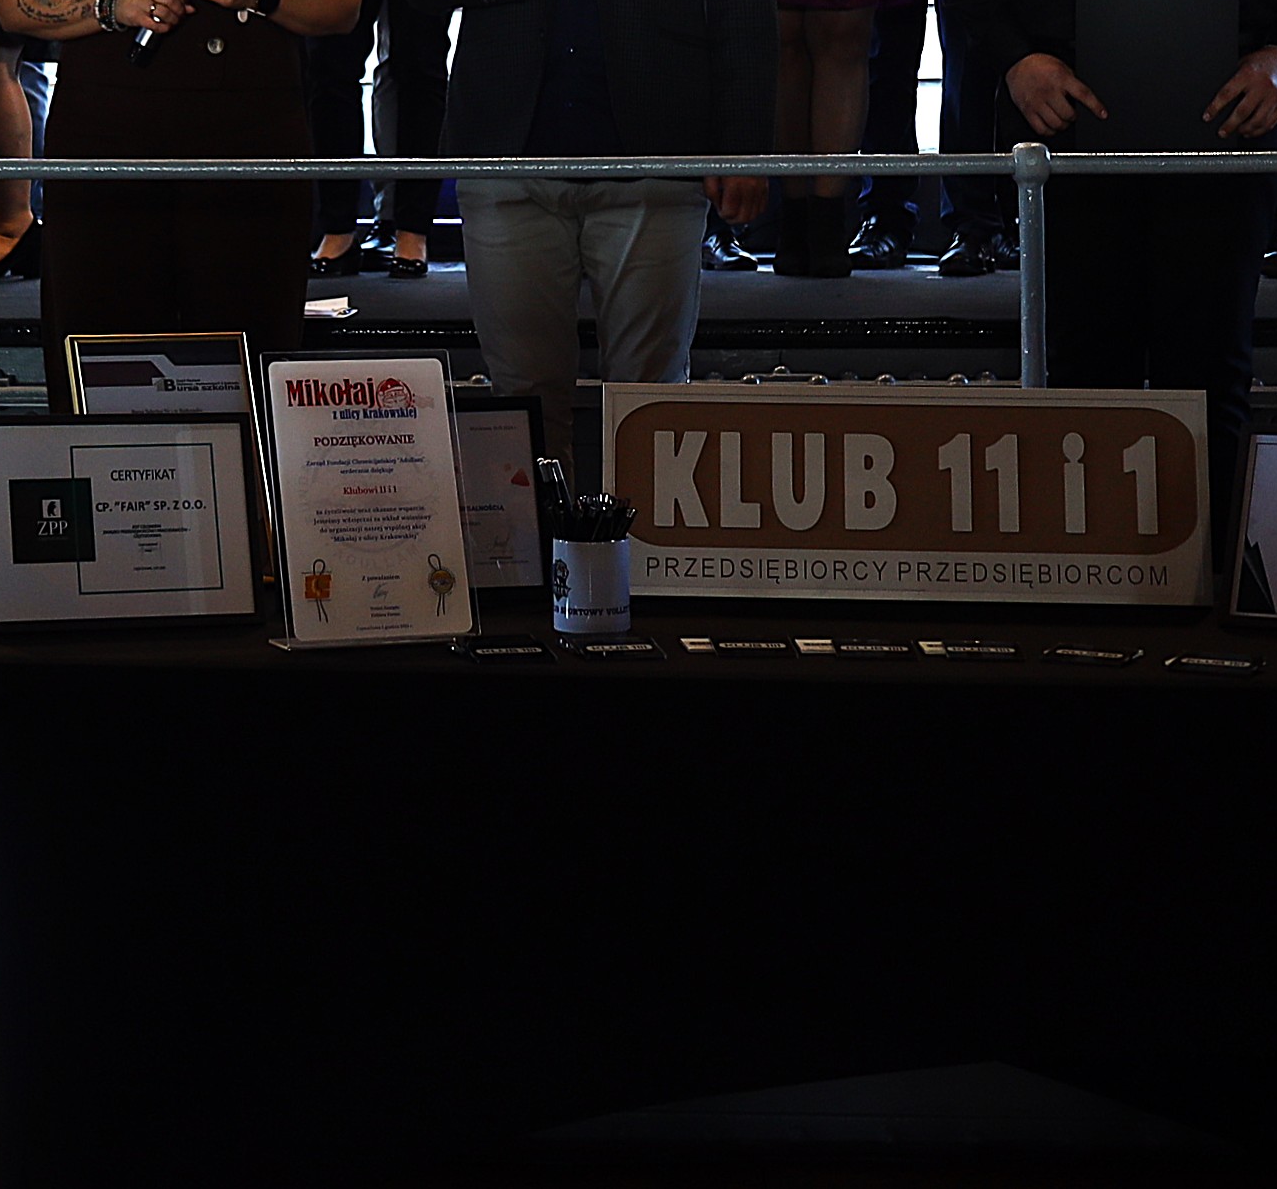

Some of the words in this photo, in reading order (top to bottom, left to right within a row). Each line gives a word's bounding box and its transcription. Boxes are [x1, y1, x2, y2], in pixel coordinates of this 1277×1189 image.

[285, 377, 375, 409] Mikołaj
[313, 434, 416, 448] PODZIĘKOWANIE
[110, 468, 177, 482] CERTYFIKAT
[652, 429, 899, 532] KLUB
[937, 431, 1021, 534] 11
[1061, 431, 1087, 535] i
[1122, 434, 1160, 537] 1
[95, 502, 113, 512] CP.
[153, 500, 172, 512] SP.
[181, 500, 207, 510] O.O.
[36, 520, 69, 537] ZPP
[645, 556, 888, 581] PRZEDSIĘBIORCY
[897, 560, 1169, 589] PRZEDSIĘBIORCOM
